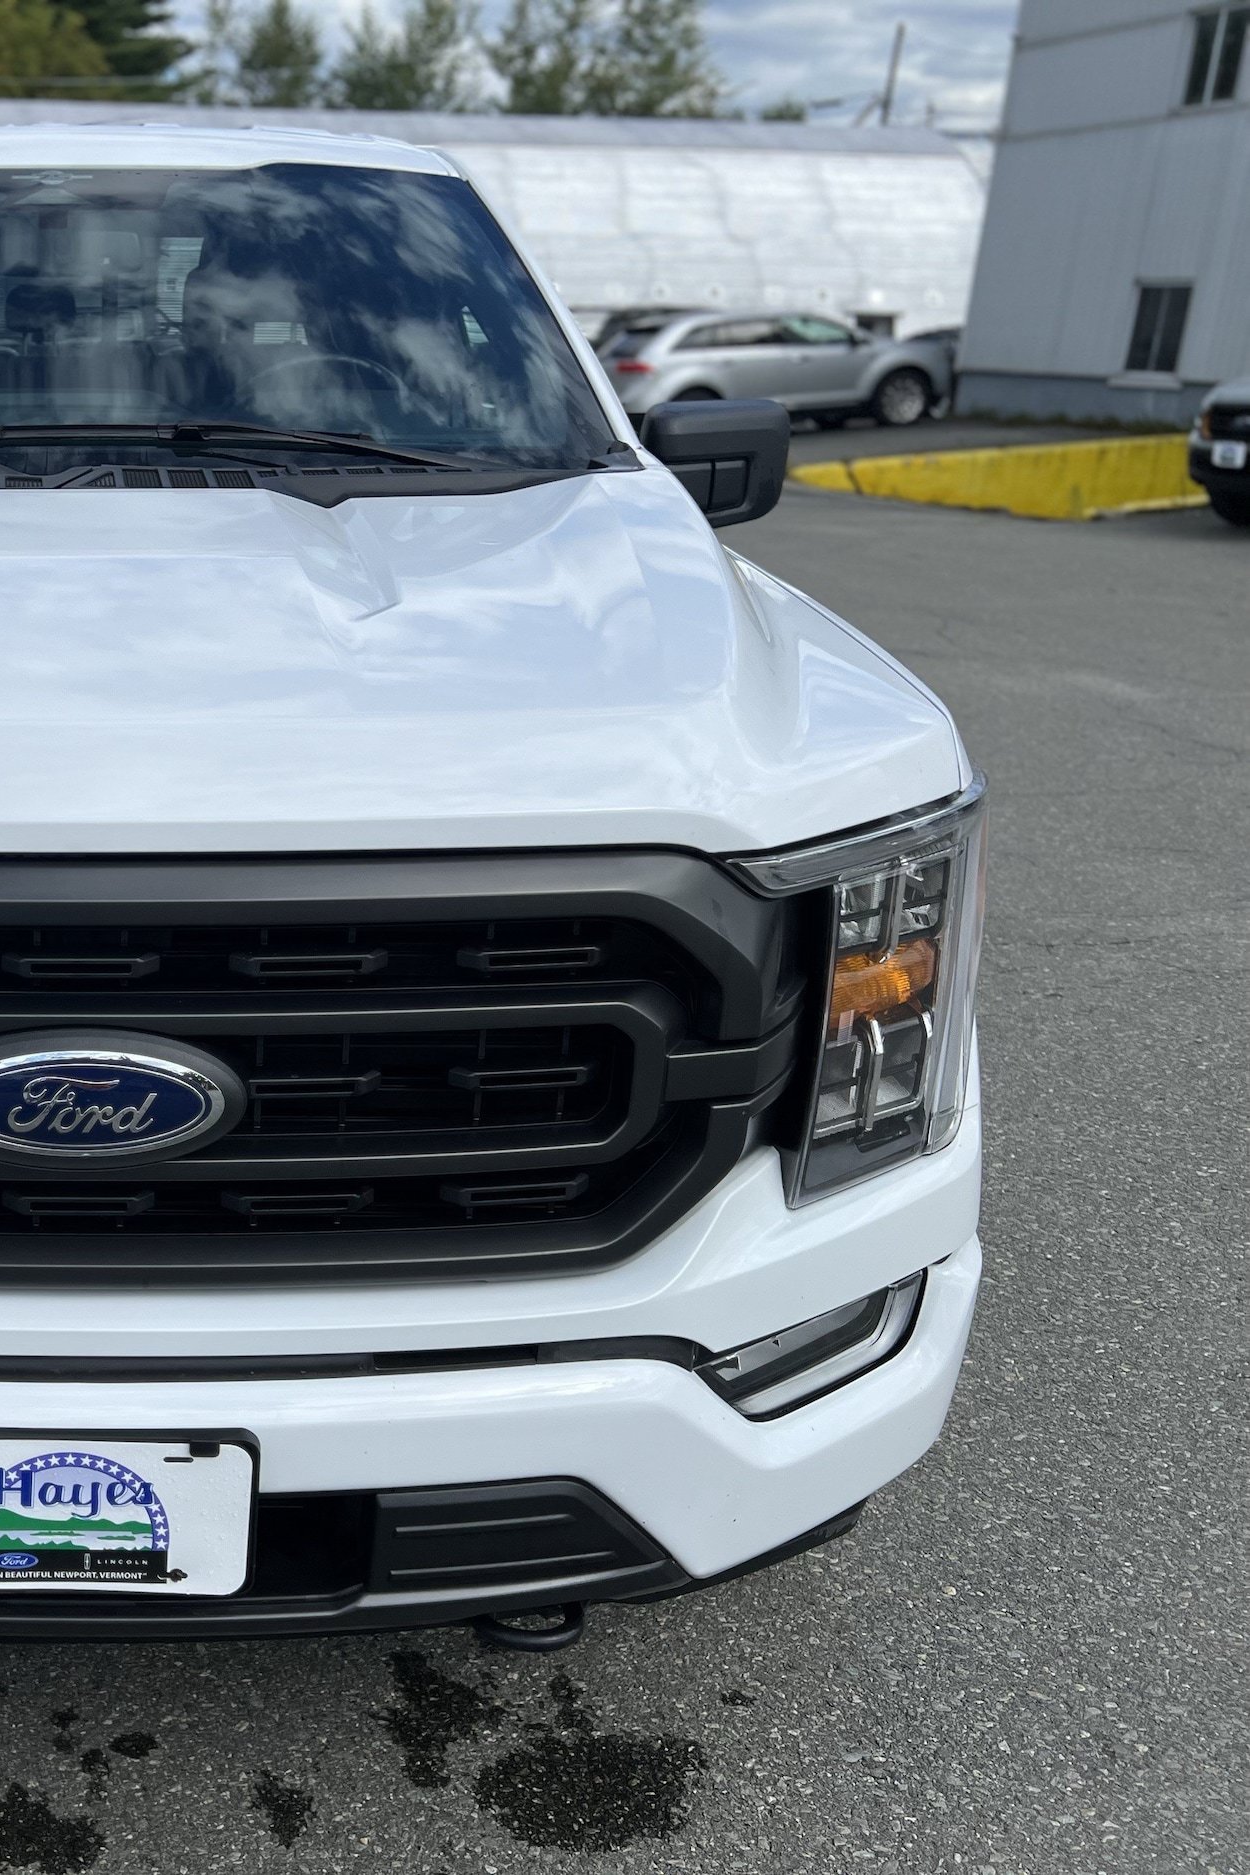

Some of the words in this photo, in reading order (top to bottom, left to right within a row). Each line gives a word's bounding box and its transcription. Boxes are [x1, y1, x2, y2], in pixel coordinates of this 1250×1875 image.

[7, 1076, 158, 1134] Ford
[1, 1555, 28, 1566] Ford
[4, 1571, 52, 1579] BEAUTIFUL
